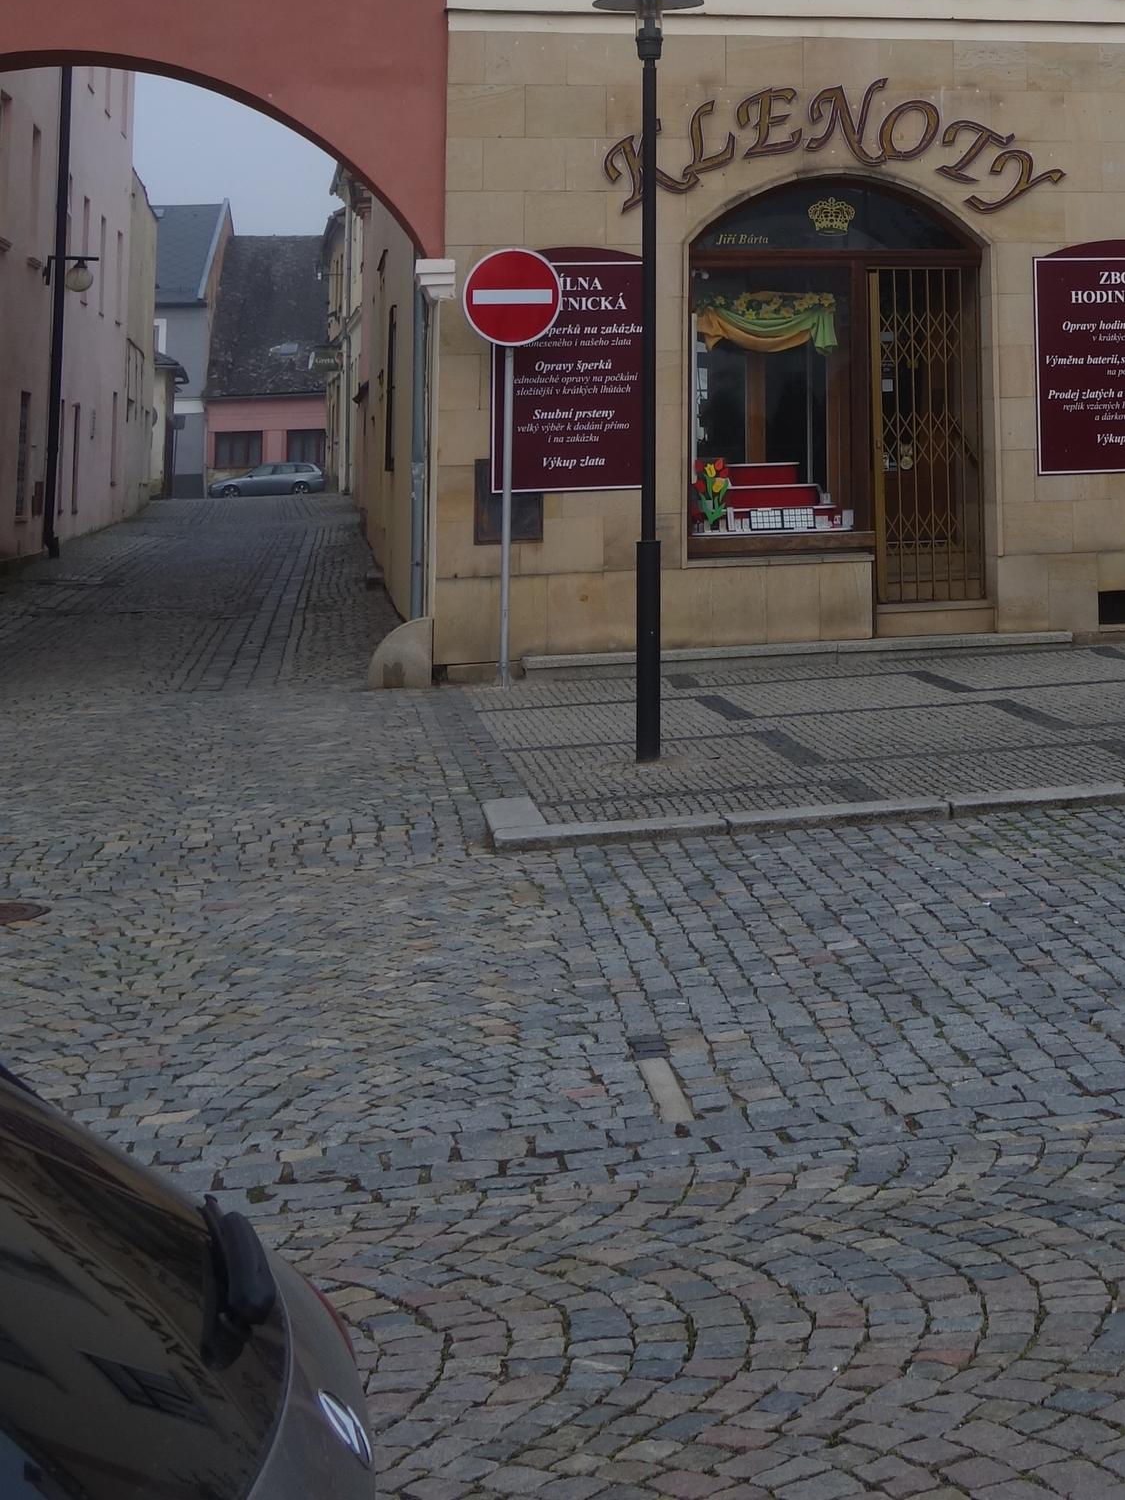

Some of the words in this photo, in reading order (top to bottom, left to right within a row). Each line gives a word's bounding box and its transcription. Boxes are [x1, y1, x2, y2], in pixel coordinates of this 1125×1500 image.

[603, 77, 1067, 215] KLENOTY
[716, 234, 736, 245] Jiří
[738, 234, 769, 245] Bárta
[559, 273, 603, 291] ÍLNA
[584, 327, 598, 335] na
[601, 323, 643, 335] zakázku
[1062, 321, 1097, 333] Opravy
[580, 337, 609, 347] našeho
[611, 337, 632, 347] zlata
[535, 361, 574, 373] Opravy
[576, 359, 612, 371] šperků
[1045, 354, 1085, 367] Výměna
[512, 374, 560, 385] ednoduché
[561, 375, 591, 384] opravy
[605, 372, 638, 383] počkání
[562, 385, 598, 396] krátkých
[1048, 389, 1080, 401] Prodej
[1081, 388, 1115, 400] zlatých
[1117, 391, 1123, 399] a
[1063, 402, 1085, 412] replik
[533, 408, 573, 420] Snubní
[574, 409, 615, 421] prsteny
[517, 424, 540, 433] velký
[542, 423, 565, 433] výběr
[573, 422, 603, 431] dodání
[566, 434, 600, 443] zakázku
[542, 457, 577, 469] Výkup
[579, 455, 606, 467] zlata
